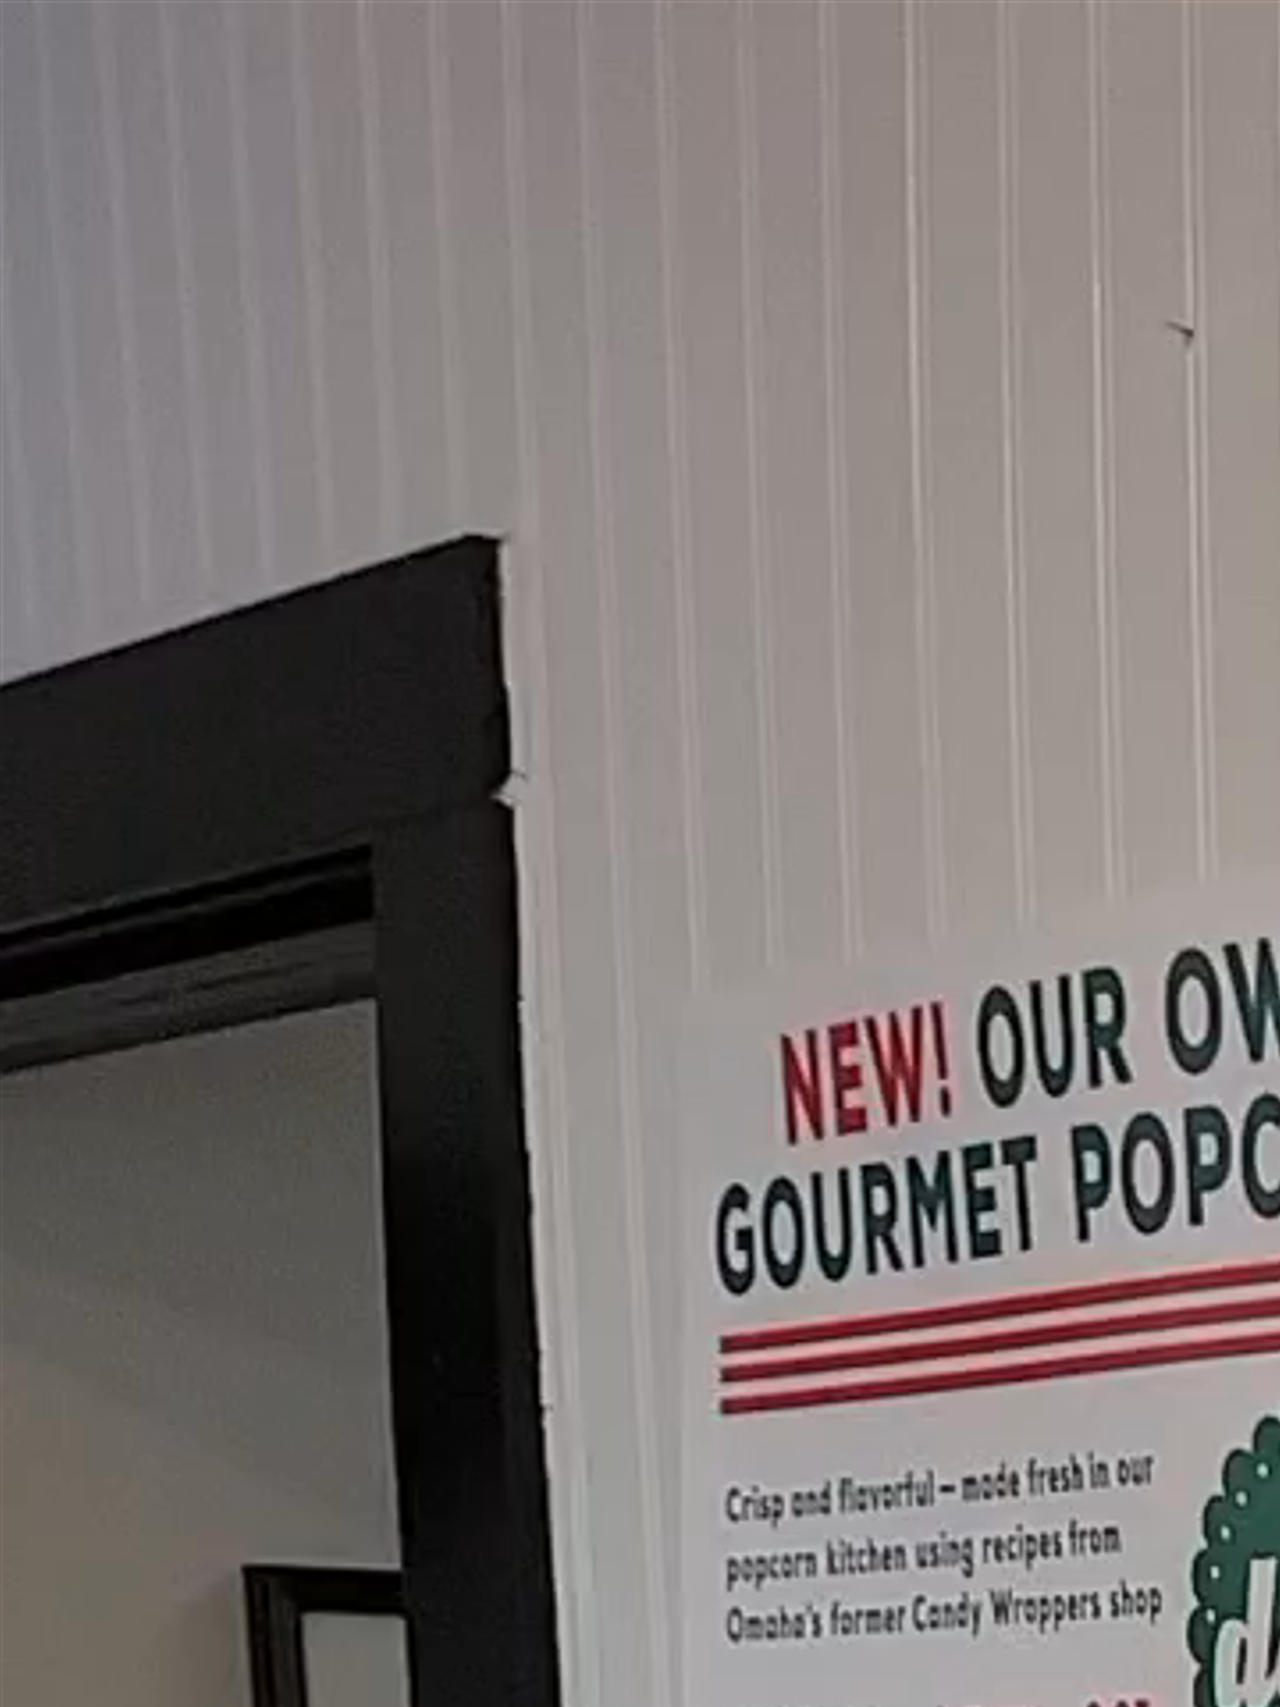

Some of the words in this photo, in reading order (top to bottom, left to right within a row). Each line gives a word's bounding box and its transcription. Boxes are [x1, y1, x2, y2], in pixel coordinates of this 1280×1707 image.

[778, 1001, 952, 1145] NEW!
[976, 966, 1133, 1107] OUR
[716, 1135, 1037, 1295] GOURMET
[725, 1486, 785, 1526] Crisp
[791, 1482, 831, 1518] and
[1026, 1453, 1083, 1494] fresh
[1088, 1452, 1109, 1488] in
[1117, 1455, 1154, 1486] our
[726, 1548, 817, 1591] popcorn
[827, 1539, 906, 1576] kitchen
[915, 1532, 973, 1577] using
[982, 1523, 1062, 1570] recipes
[1069, 1520, 1121, 1557] from
[726, 1604, 822, 1643] Omaha's
[831, 1601, 906, 1637] former
[912, 1594, 982, 1636] Candy
[990, 1589, 1102, 1633] Wrappers
[1110, 1580, 1162, 1622] shop
